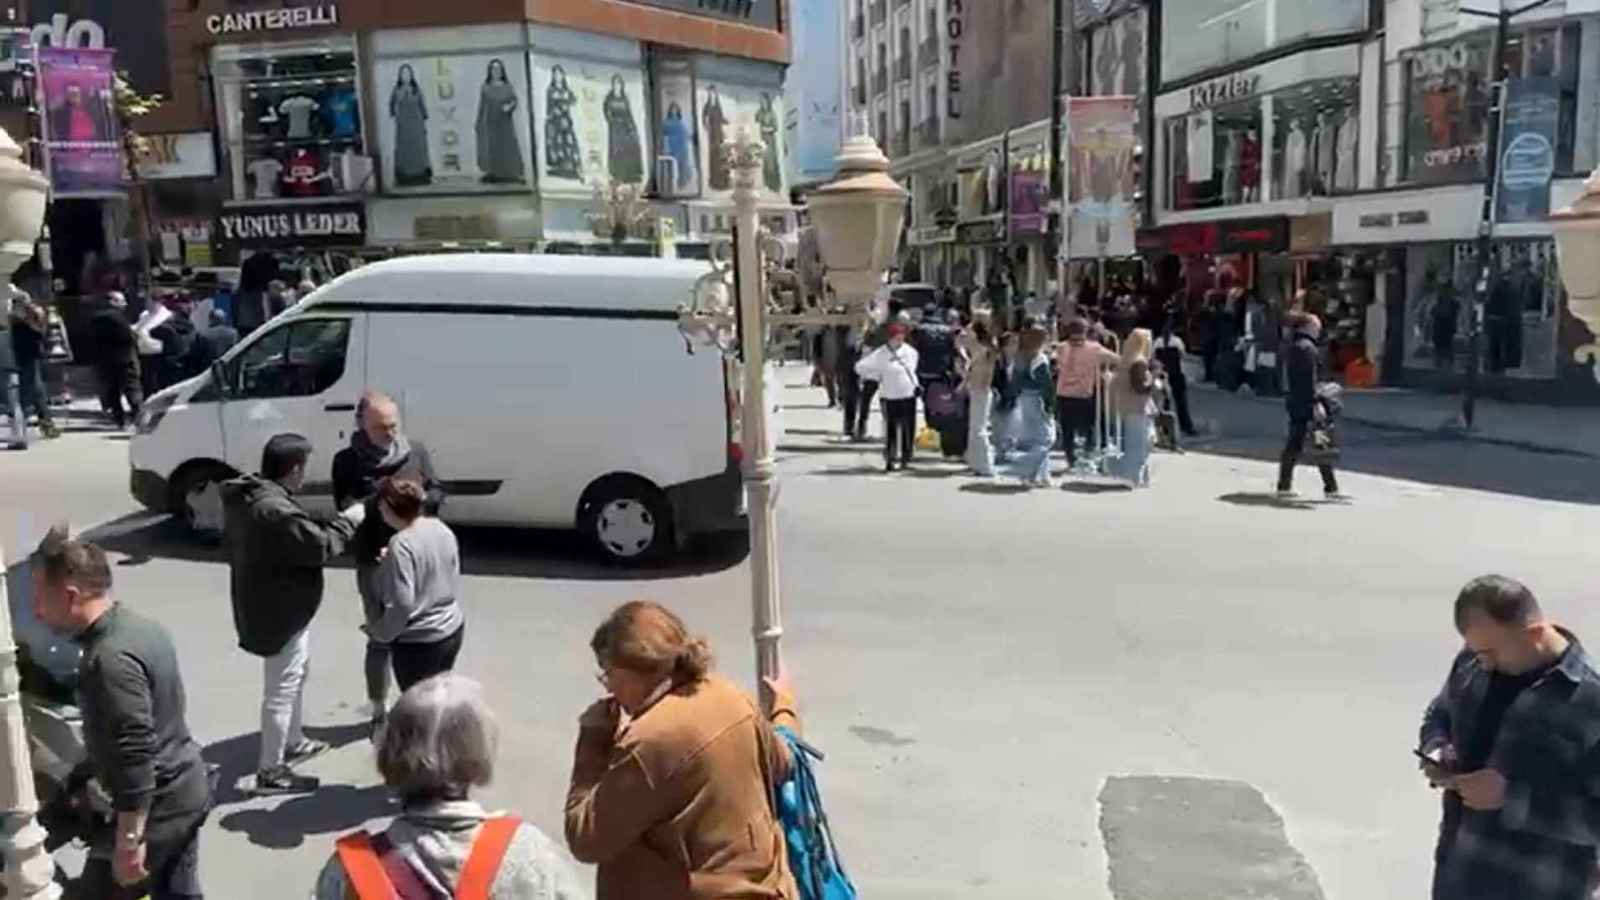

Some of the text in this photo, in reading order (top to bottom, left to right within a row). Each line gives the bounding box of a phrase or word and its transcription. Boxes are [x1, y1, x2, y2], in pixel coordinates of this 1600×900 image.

[206, 4, 337, 34] CANTERELLI
[220, 209, 290, 238] YUNUS
[294, 211, 361, 235] LEDER
